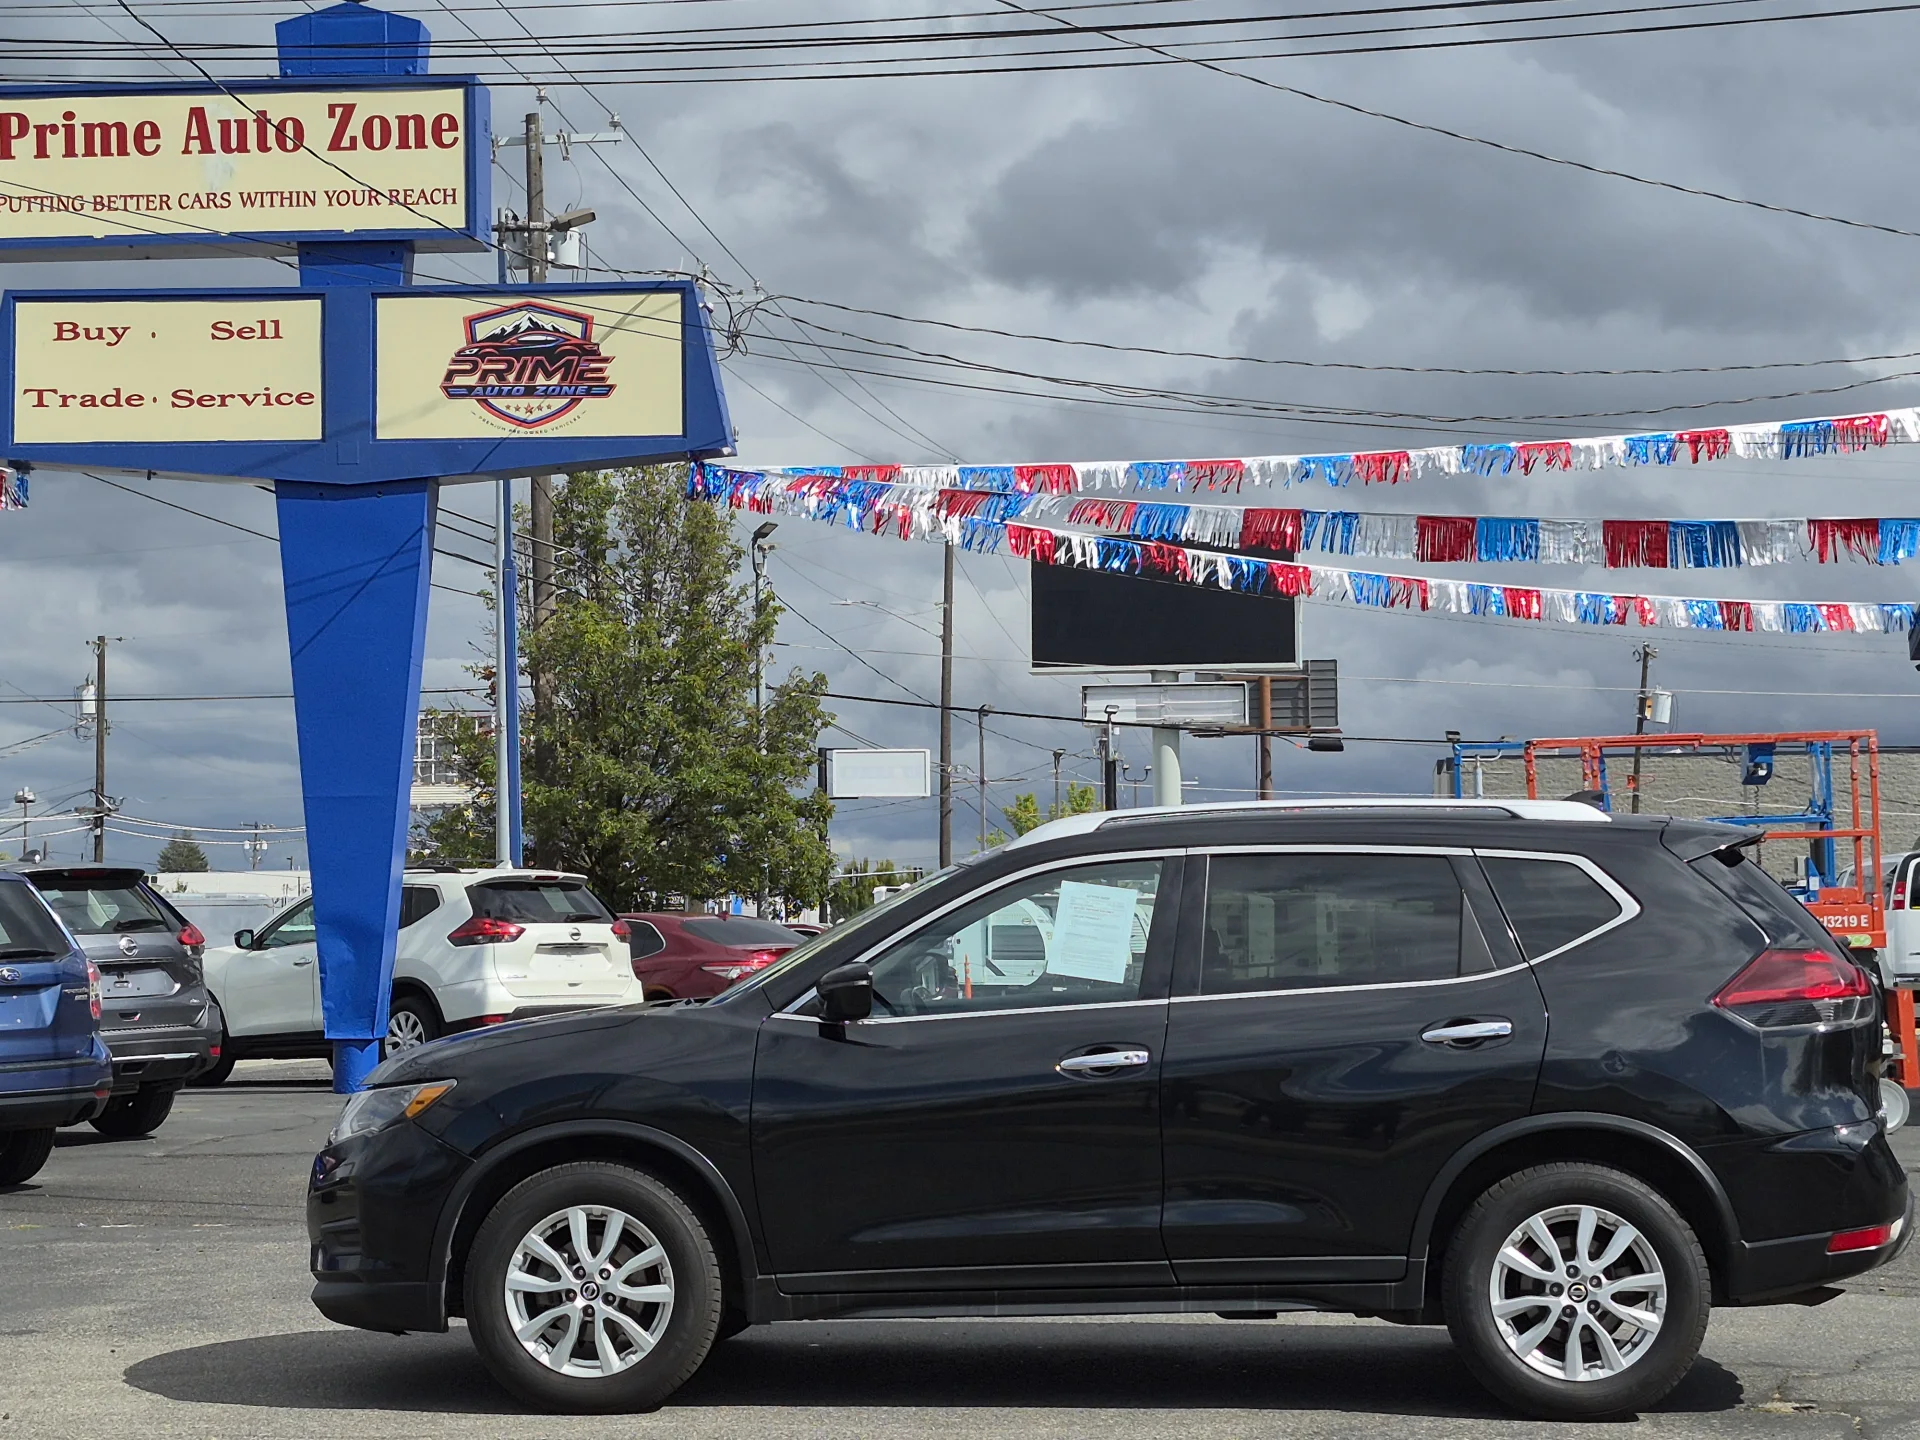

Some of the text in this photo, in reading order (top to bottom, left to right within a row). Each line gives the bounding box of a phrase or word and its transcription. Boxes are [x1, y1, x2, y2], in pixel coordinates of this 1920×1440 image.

[0, 103, 459, 160] Prime Auto Zone
[0, 188, 457, 213] PUTTING BETTER CARS WITHIN YOUR REACH
[53, 319, 283, 347] Buy Sell
[442, 355, 617, 385] PRIME
[23, 387, 315, 408] Trade Service
[470, 385, 589, 397] AUTO ZONE
[1817, 914, 1869, 928] J3219 E
